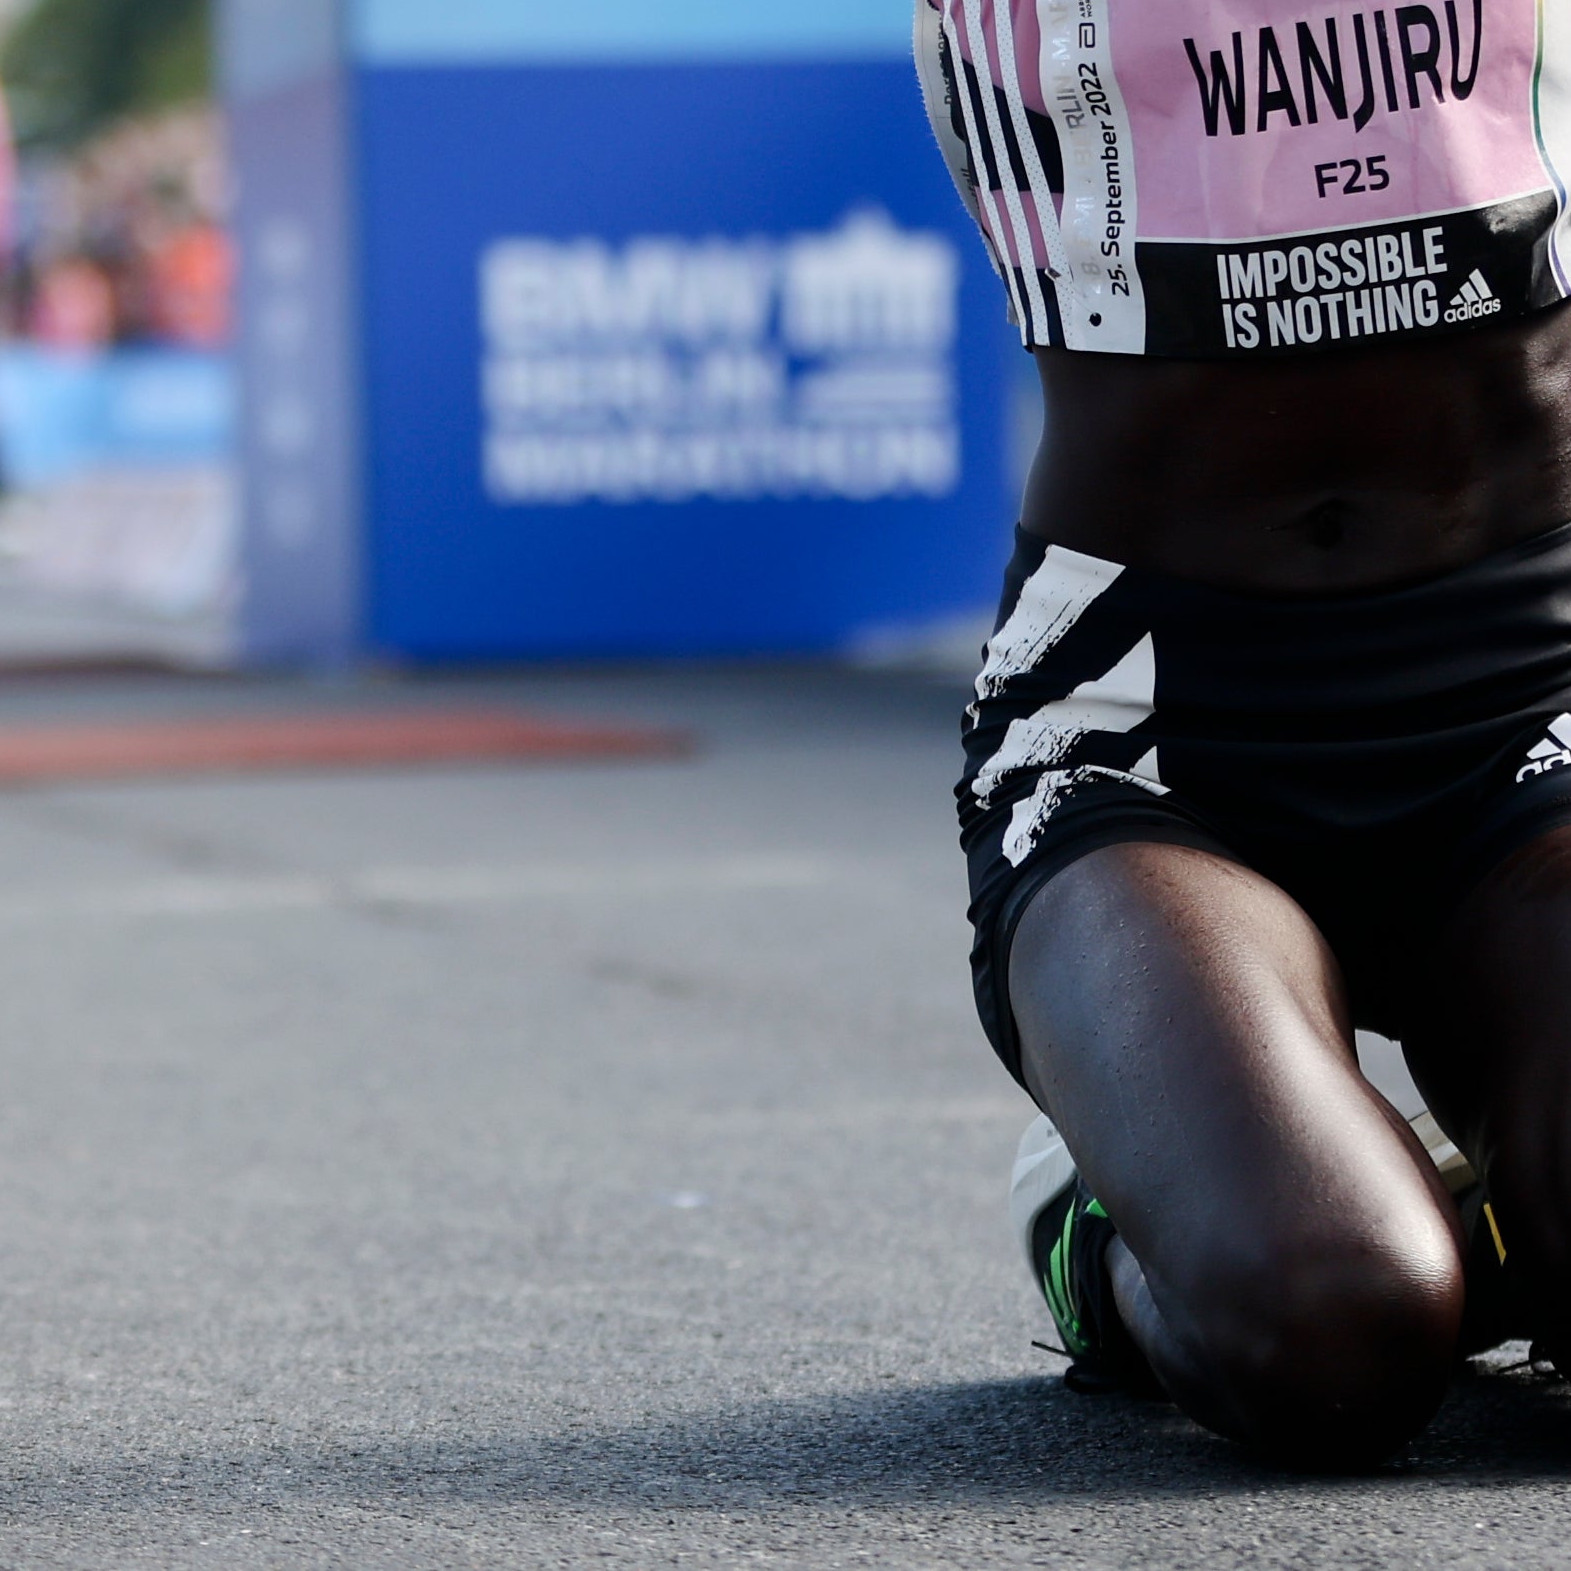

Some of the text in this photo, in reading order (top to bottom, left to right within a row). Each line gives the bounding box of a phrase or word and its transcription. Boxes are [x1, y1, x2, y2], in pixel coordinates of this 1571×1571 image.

[1078, 62, 1130, 297] 25. September 2022
[1314, 155, 1390, 198] F25
[482, 237, 779, 341] BMW
[1217, 226, 1448, 299] IMPOSSIBLE
[1222, 279, 1502, 349] IS NOTHING adidas
[484, 349, 789, 419] BERLIN
[485, 429, 959, 502] MARATHON
